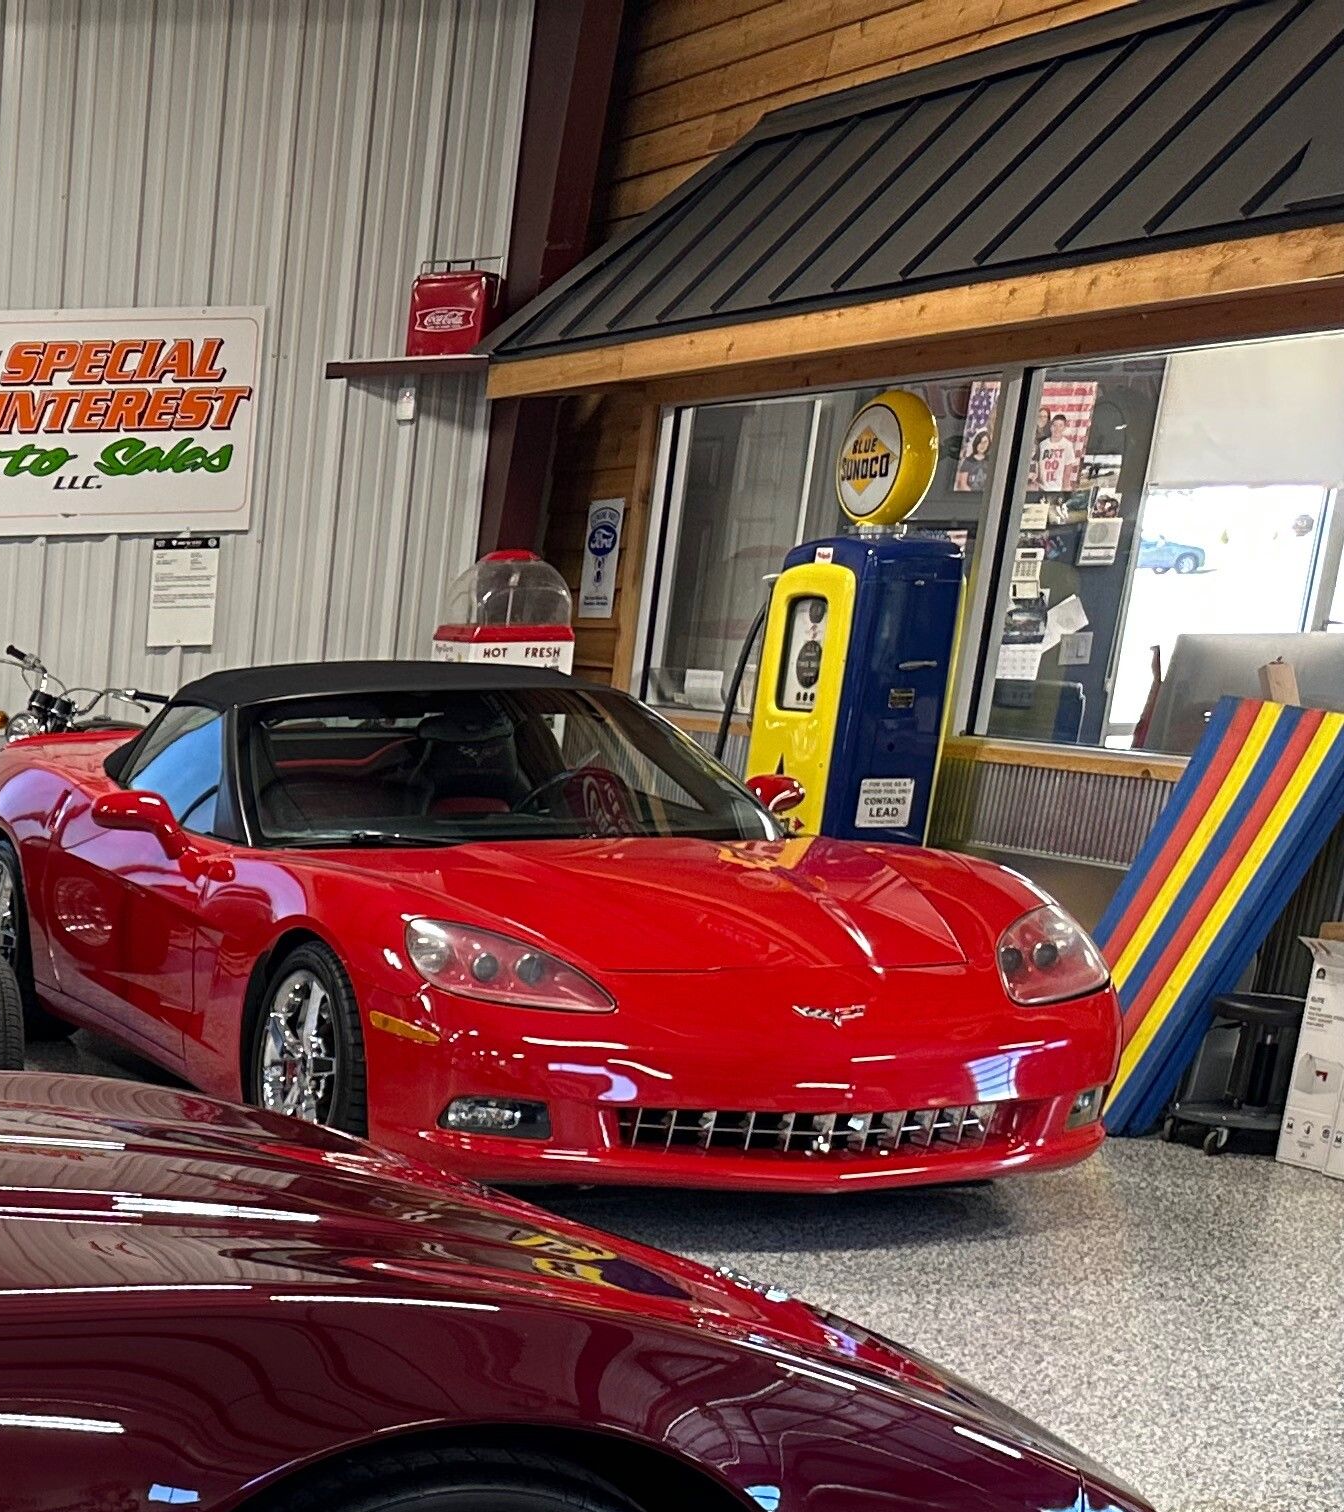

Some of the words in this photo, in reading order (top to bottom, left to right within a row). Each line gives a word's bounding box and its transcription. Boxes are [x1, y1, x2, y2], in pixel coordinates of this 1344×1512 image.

[0, 338, 227, 386] SPECIAL
[852, 437, 878, 455] BLUE
[94, 437, 234, 475] Sales
[841, 452, 891, 481] SUNOCO
[53, 475, 103, 490] LLC.
[483, 647, 509, 659] HOT
[524, 646, 562, 659] FRESH
[864, 796, 907, 806] CONTAINS
[868, 807, 899, 818] LEAD
